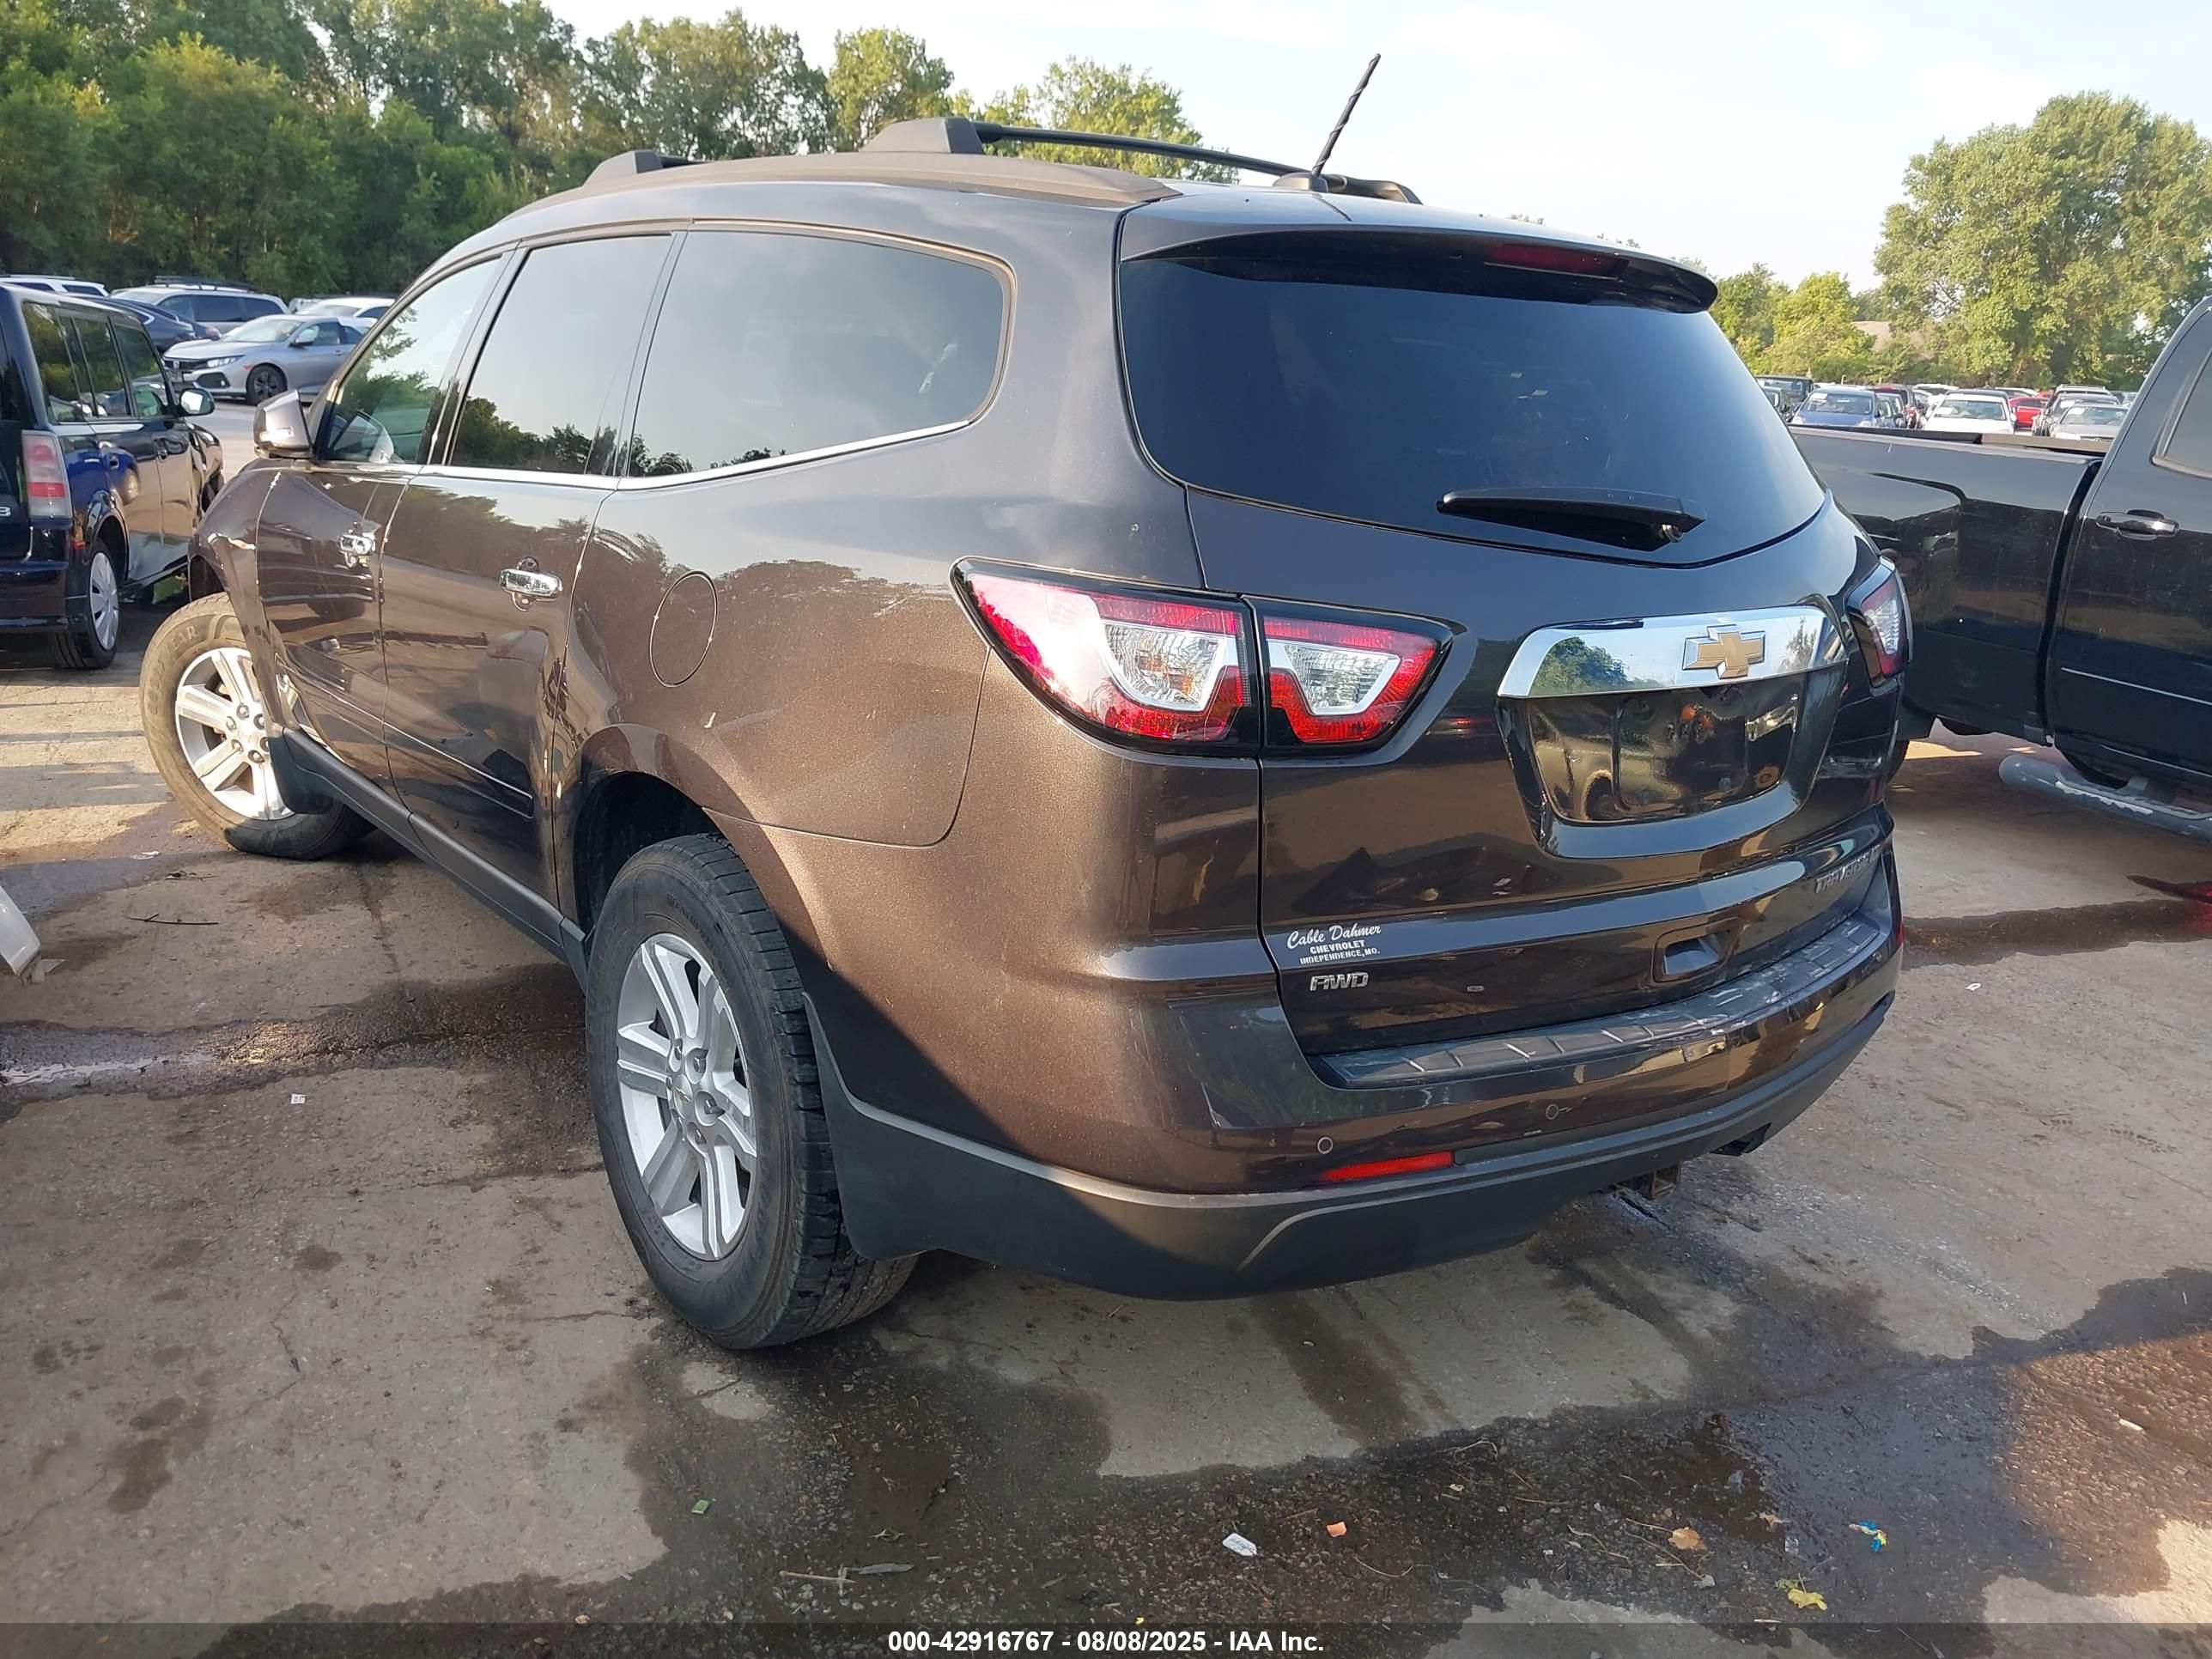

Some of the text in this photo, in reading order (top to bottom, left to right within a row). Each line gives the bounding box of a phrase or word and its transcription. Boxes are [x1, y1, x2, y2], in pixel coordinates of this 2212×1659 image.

[1286, 922, 1382, 950] Cable Dahmer
[1310, 939, 1365, 955] CHEVROLET
